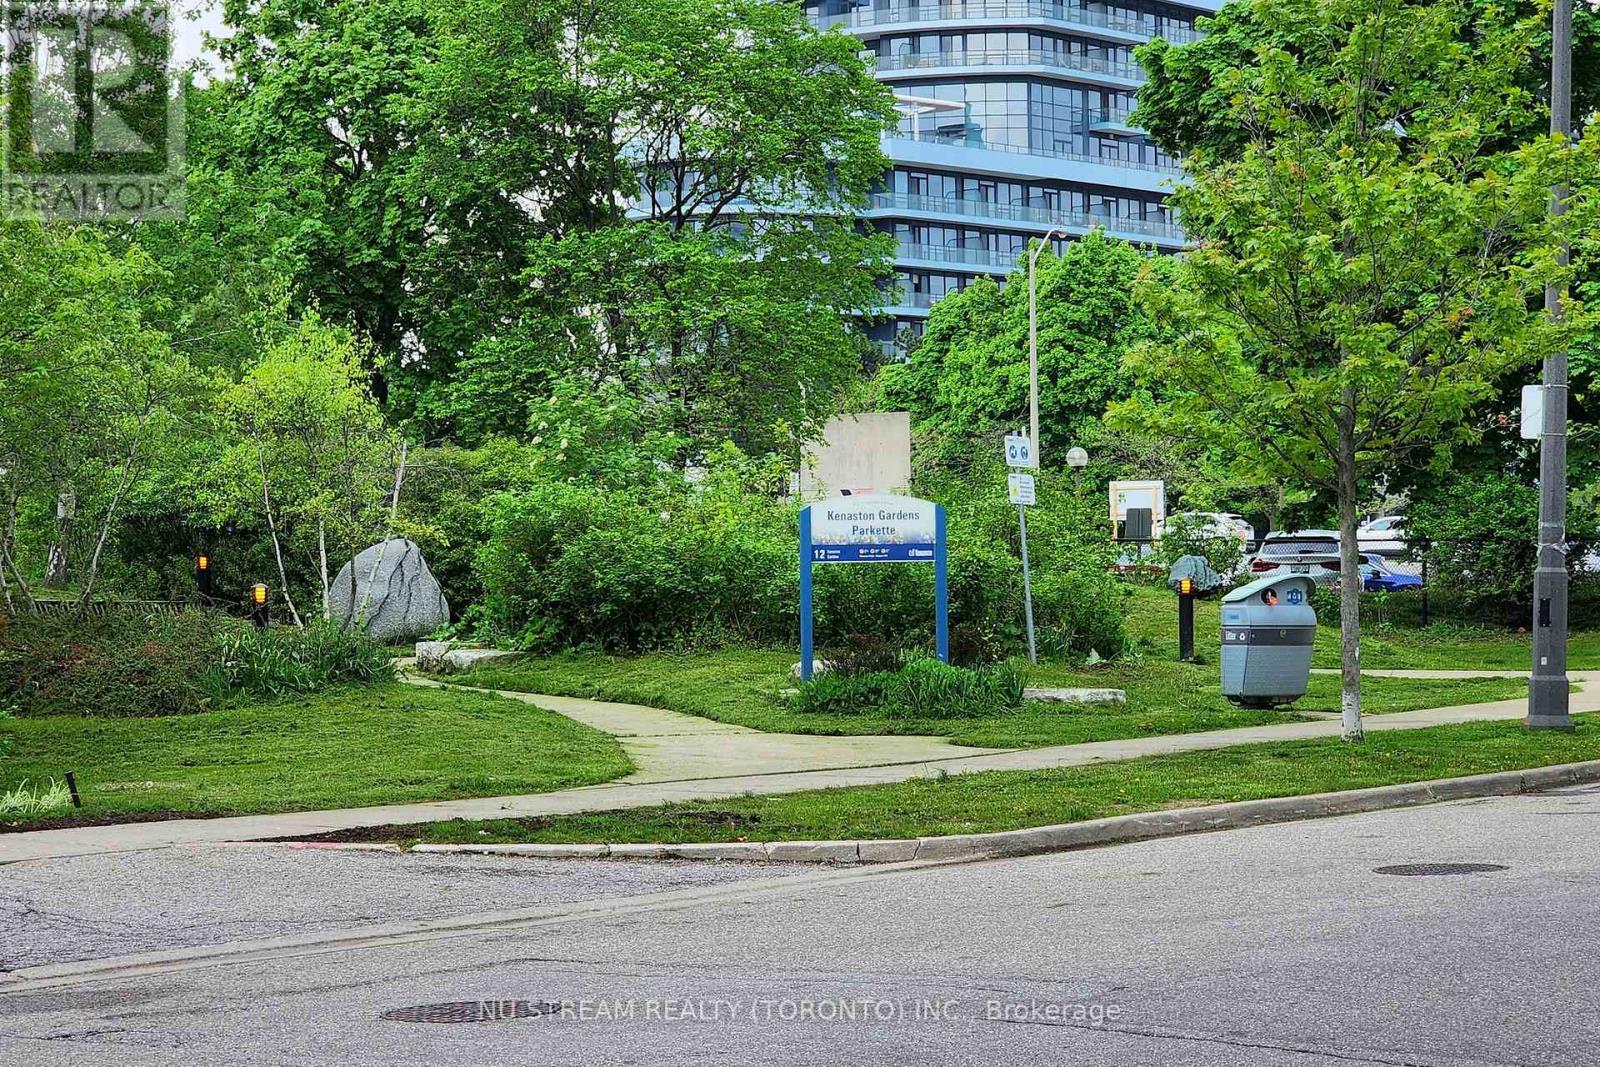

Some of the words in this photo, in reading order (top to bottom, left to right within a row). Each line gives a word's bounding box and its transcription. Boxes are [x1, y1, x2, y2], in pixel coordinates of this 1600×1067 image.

[827, 510, 875, 521] Kenaston
[878, 509, 920, 521] Gardens
[852, 525, 896, 536] Parkette
[814, 549, 826, 559] 12
